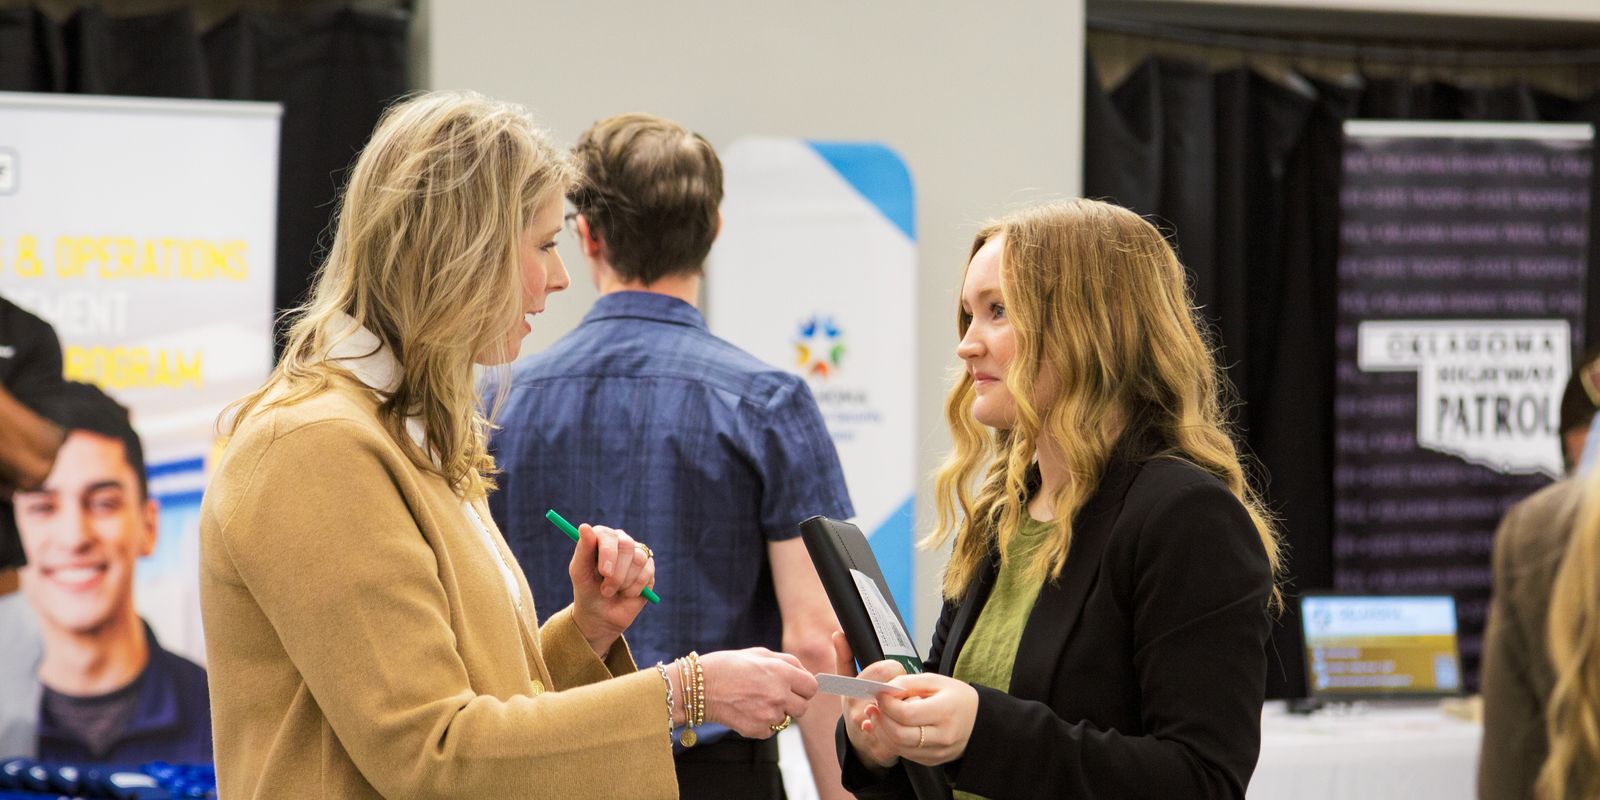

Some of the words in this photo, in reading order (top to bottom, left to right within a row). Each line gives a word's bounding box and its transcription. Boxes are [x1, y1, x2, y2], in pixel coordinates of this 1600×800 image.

[15, 234, 43, 278] &
[55, 235, 248, 281] OPERATIONS
[1387, 333, 1554, 356] OKLAHOMA
[64, 346, 203, 389] ROGRAM
[1437, 394, 1559, 436] PATROL
